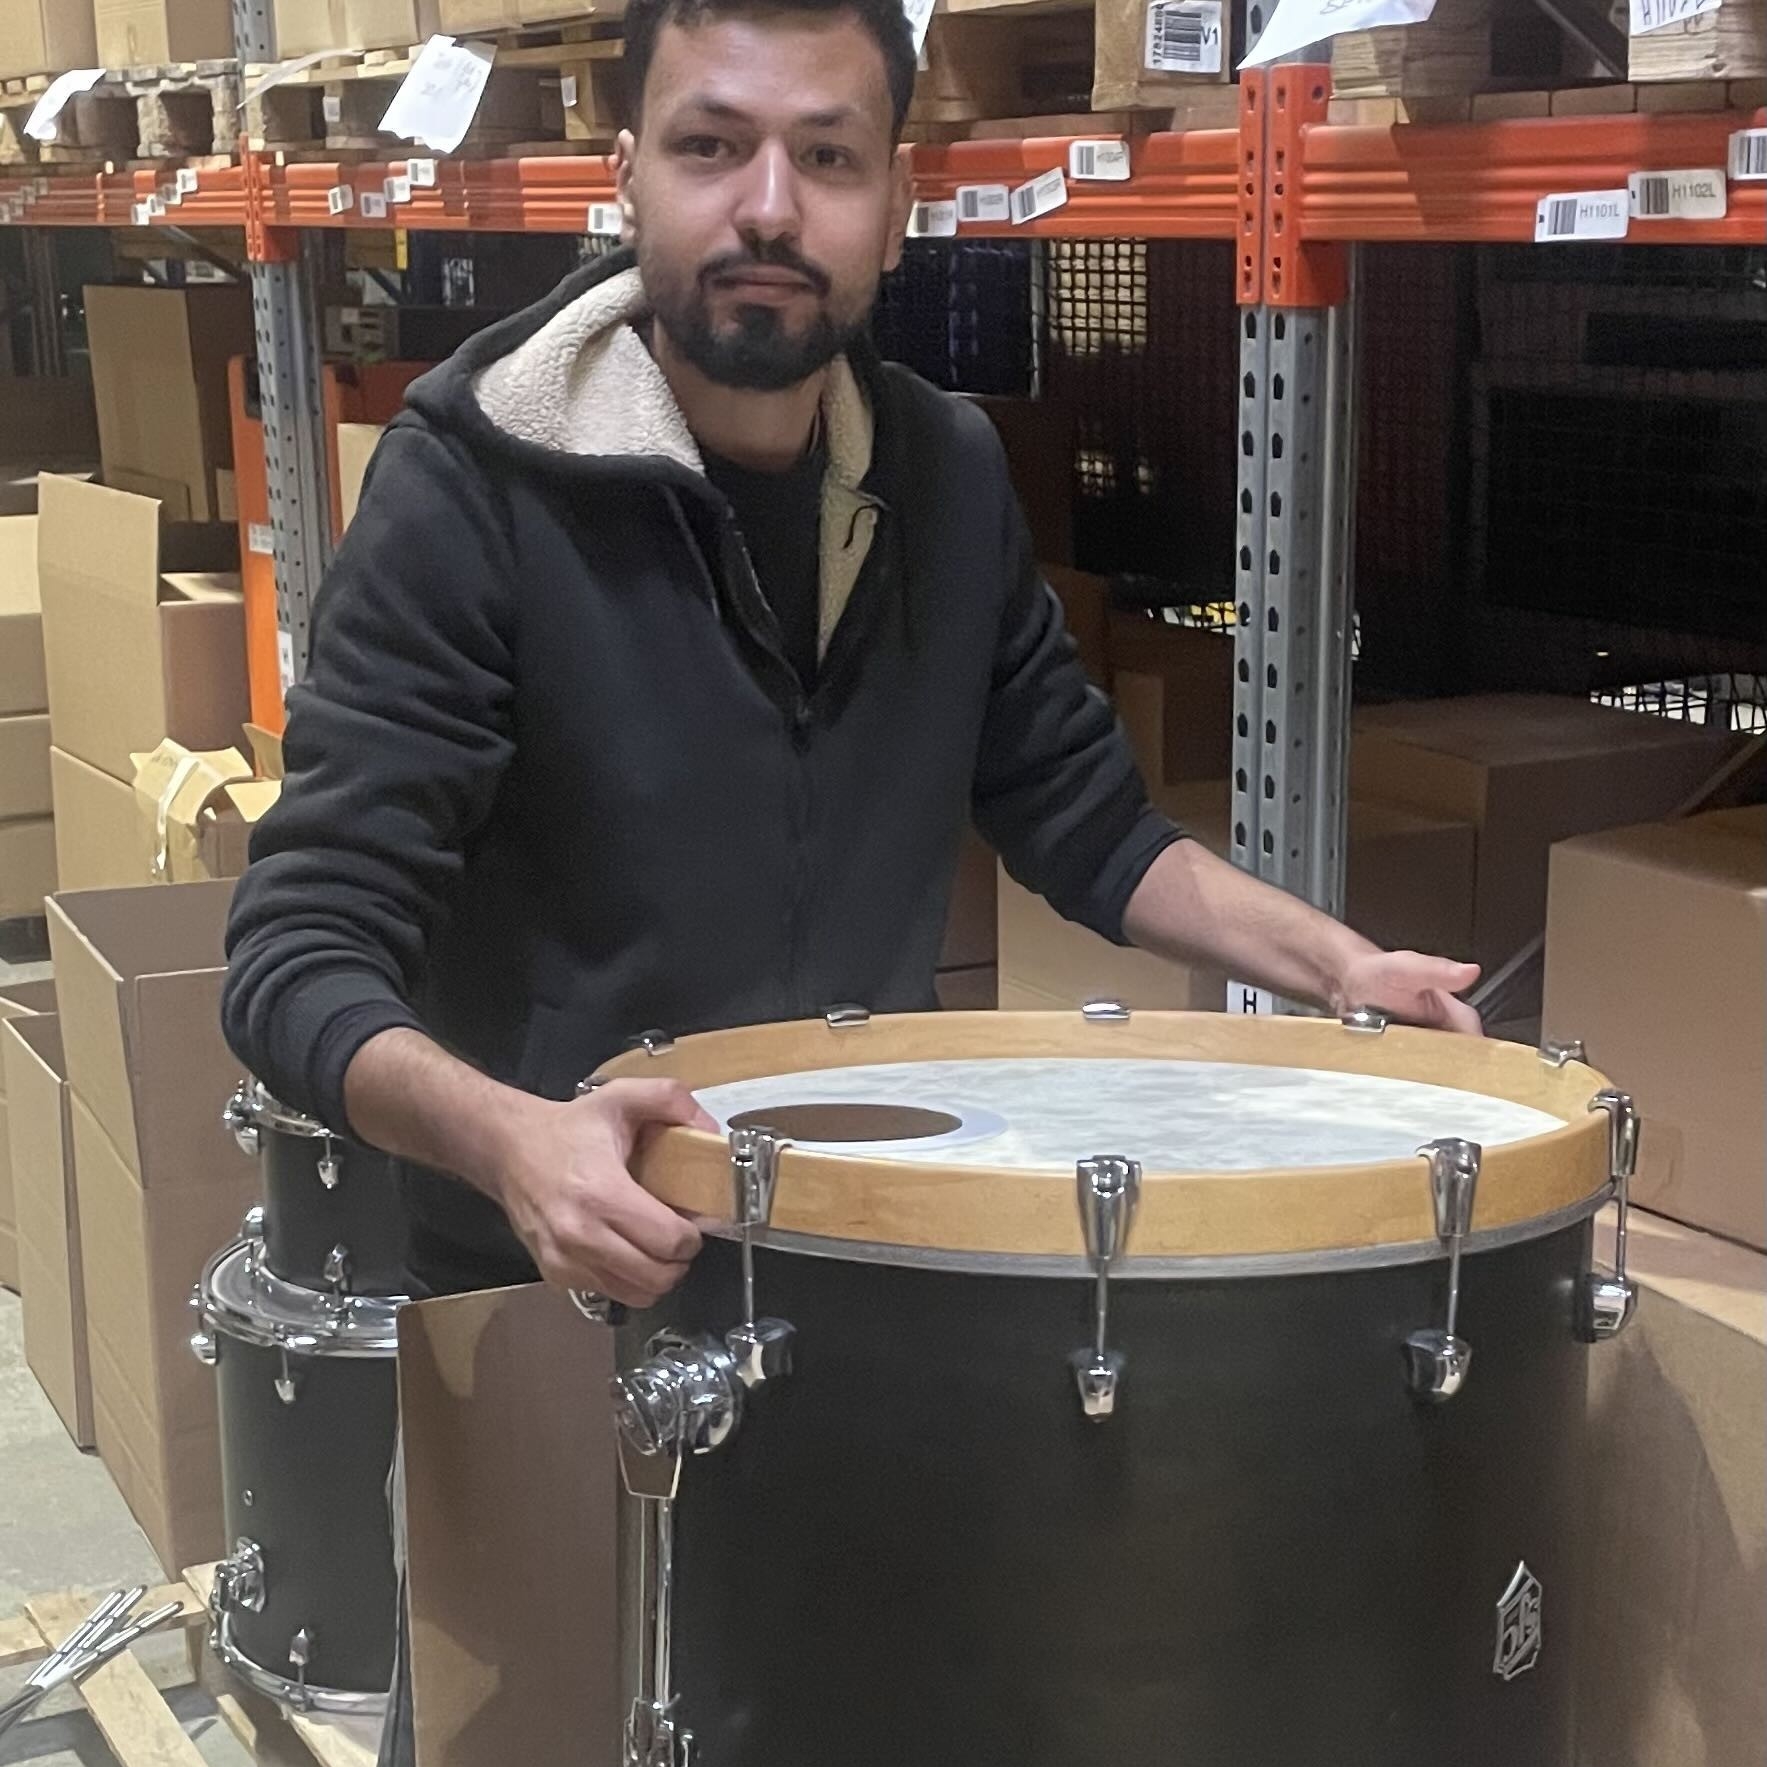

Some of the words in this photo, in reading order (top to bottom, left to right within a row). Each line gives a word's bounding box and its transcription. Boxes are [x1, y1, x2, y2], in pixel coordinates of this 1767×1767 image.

[1201, 25, 1218, 45] V1
[1671, 182, 1717, 199] H1102L
[1579, 202, 1620, 219] H1101L
[1243, 988, 1257, 1014] H
